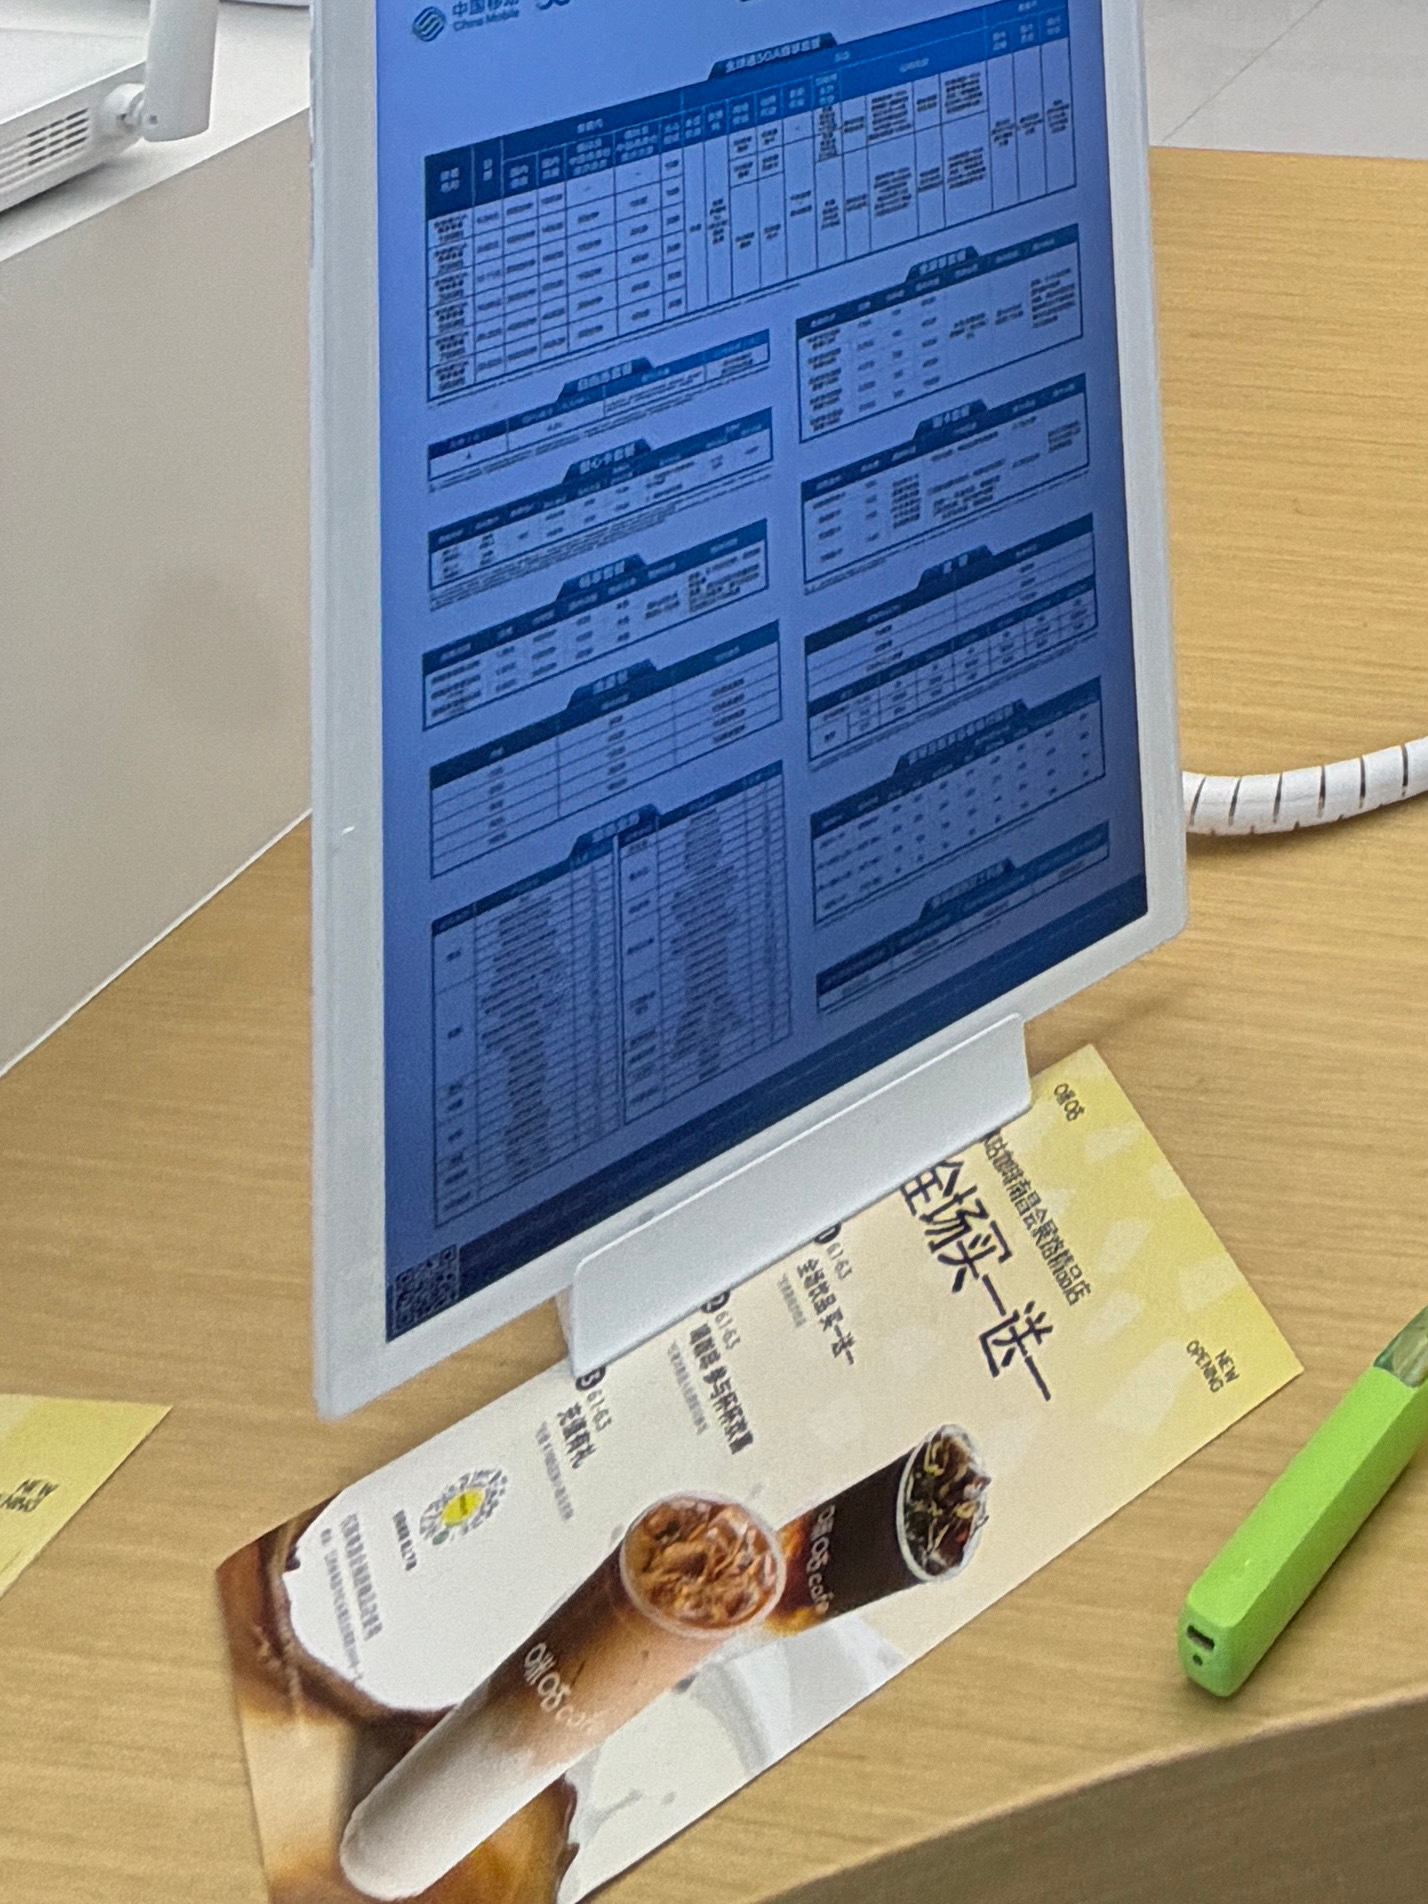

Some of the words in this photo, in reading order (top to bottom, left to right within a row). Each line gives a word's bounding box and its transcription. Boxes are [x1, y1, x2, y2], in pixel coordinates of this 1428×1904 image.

[453, 17, 484, 32] China
[486, 9, 520, 24] Mobile
[902, 1159, 1053, 1402] 全场买一送一
[797, 1258, 836, 1316] 全场饮品
[820, 1306, 856, 1365] 买一送一
[1186, 1340, 1224, 1393] OPENING
[1215, 1349, 1240, 1383] NEW
[557, 1402, 597, 1470] 充值有礼
